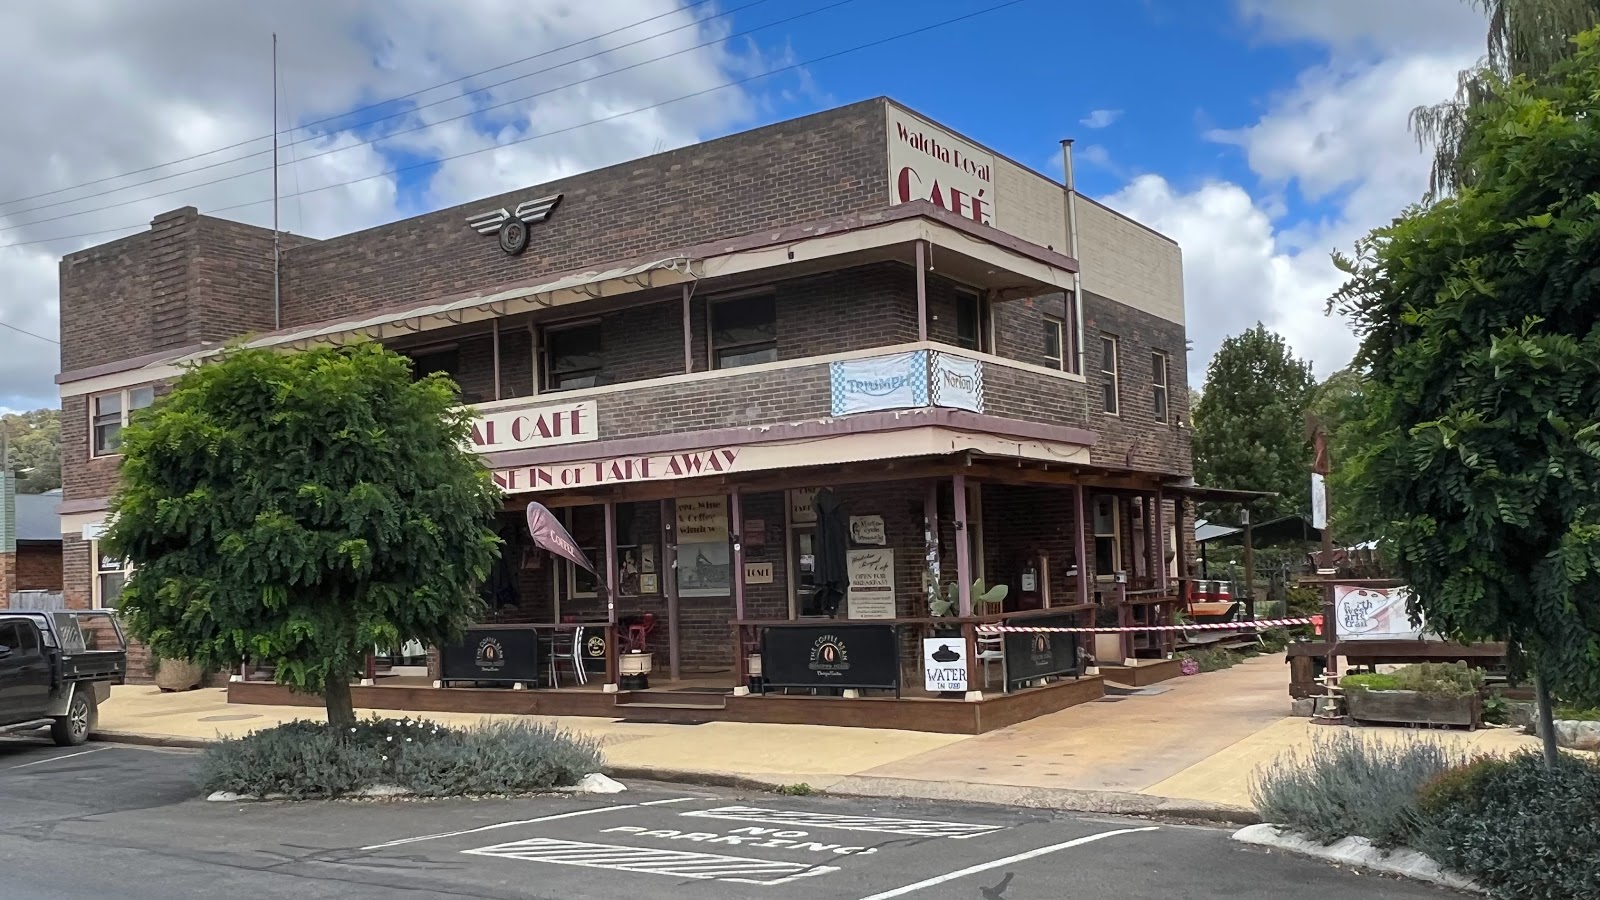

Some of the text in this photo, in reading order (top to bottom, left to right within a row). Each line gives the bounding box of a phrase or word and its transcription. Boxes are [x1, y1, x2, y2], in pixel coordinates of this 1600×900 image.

[896, 121, 990, 183] Walcha Royal
[846, 374, 915, 394] TRIUMPH
[941, 367, 974, 394] Norton
[511, 404, 590, 443] CAFÉ
[529, 466, 553, 487] IN
[561, 466, 584, 486] or
[595, 456, 657, 482] TAKE
[664, 448, 741, 477] AWAY
[814, 634, 838, 647] COFFEE
[927, 668, 968, 682] WATER
[937, 682, 946, 690] IN
[600, 826, 878, 856] PARKING
[727, 826, 809, 839] NO
